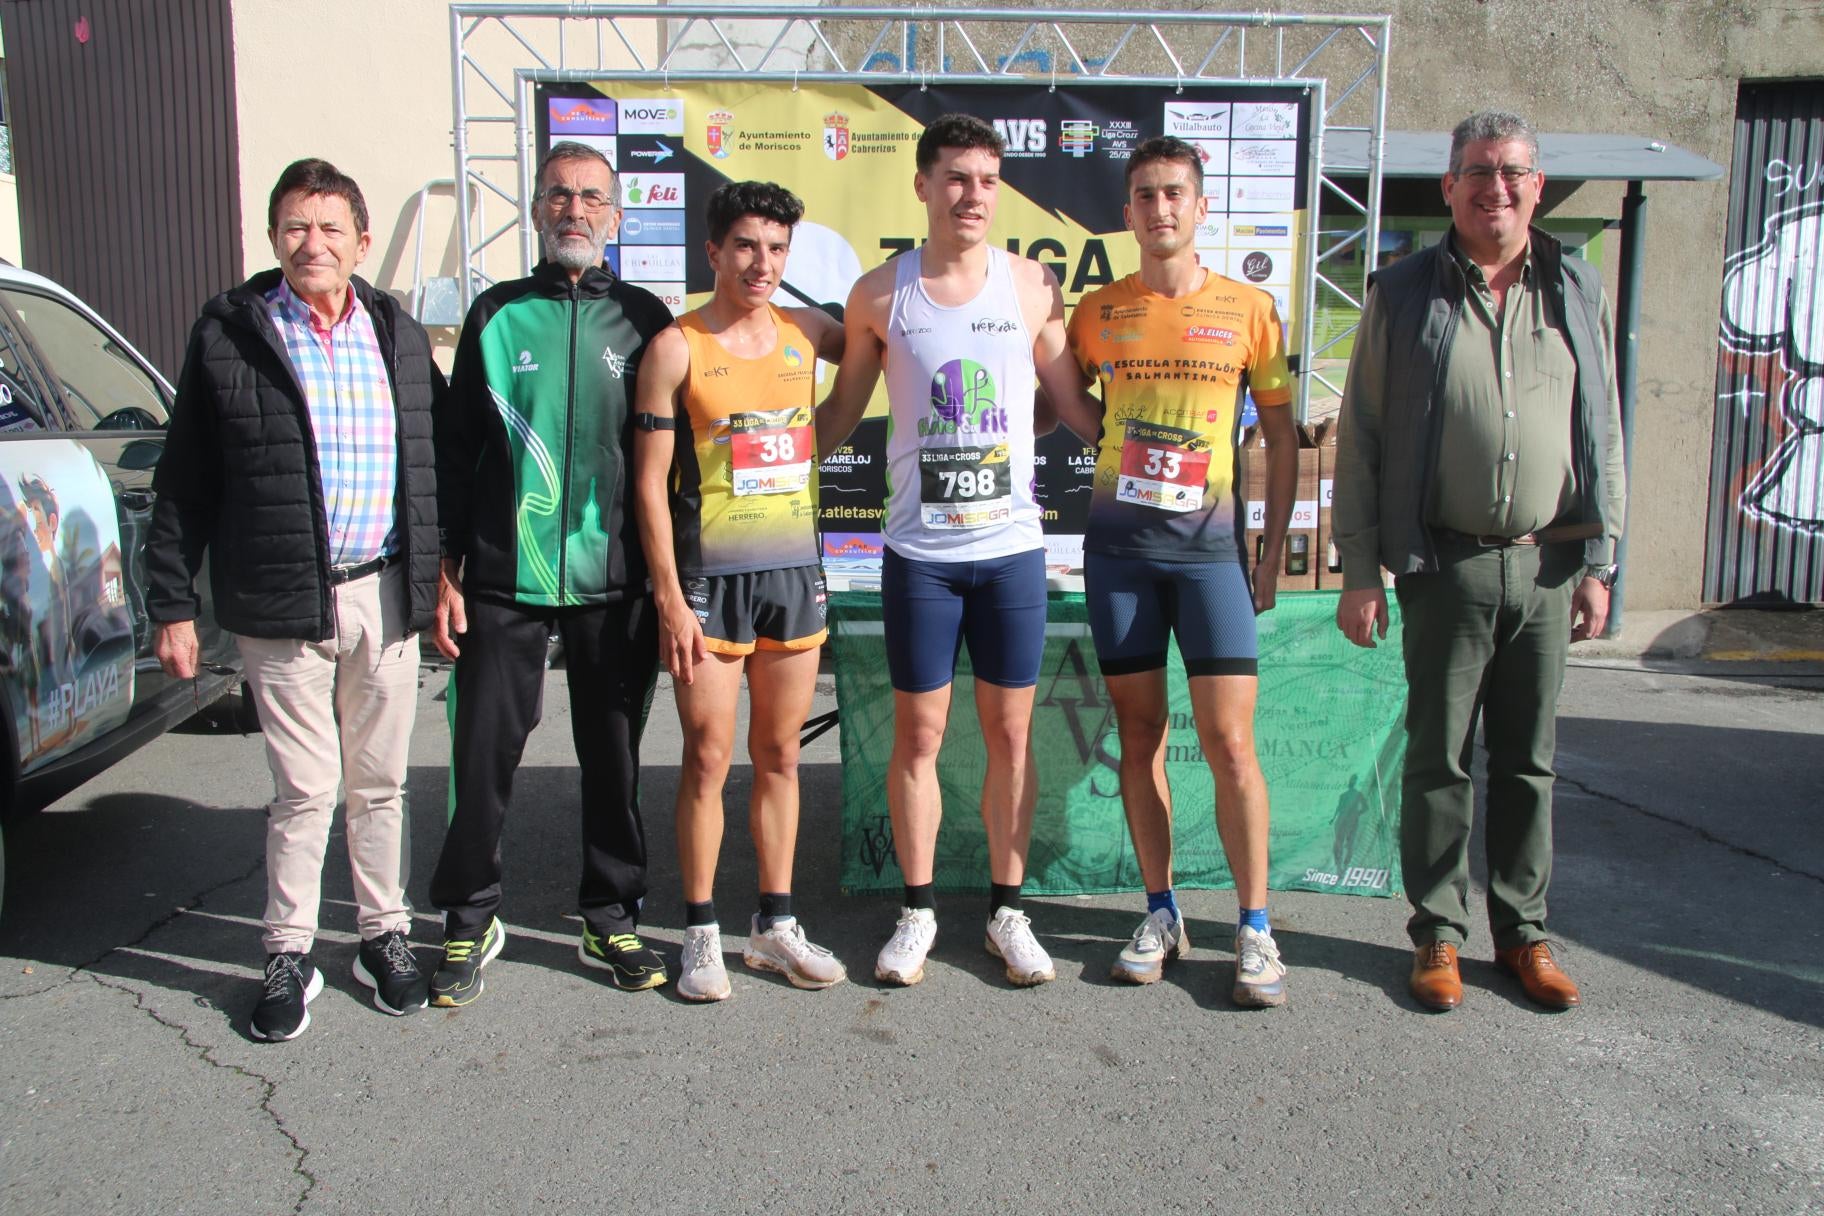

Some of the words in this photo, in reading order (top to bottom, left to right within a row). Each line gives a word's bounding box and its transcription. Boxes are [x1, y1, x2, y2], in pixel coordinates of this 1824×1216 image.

[1173, 122, 1222, 131] Villalbauto
[739, 131, 811, 141] Ayuntamiento
[851, 132, 910, 142] Ayuntamiento
[993, 119, 1047, 151] AVS
[754, 142, 801, 151] Moriscos
[851, 144, 896, 153] Cabrerizos
[1109, 151, 1131, 159] 25/26
[646, 184, 678, 204] feli
[512, 363, 539, 373] VIATOR
[1115, 359, 1170, 369] ESCUELA
[1126, 371, 1217, 383] SALMANTINA
[980, 407, 1007, 434] fit
[1157, 430, 1183, 442] CROSS
[759, 432, 795, 463] 38
[921, 453, 932, 462] 33
[932, 452, 949, 462] LIGA
[955, 451, 981, 461] CROSS
[1068, 456, 1082, 466] LA
[1084, 456, 1097, 466] CL
[1144, 447, 1183, 479] 33
[1075, 467, 1095, 475] CABR
[939, 468, 995, 498] 798
[728, 512, 767, 522] HERRERO
[926, 508, 1009, 525] JOMISAGA
[47, 663, 118, 730] #PLAYA
[1261, 738, 1348, 759] MANCA
[1302, 868, 1338, 886] Since
[1340, 866, 1389, 889] 1990
